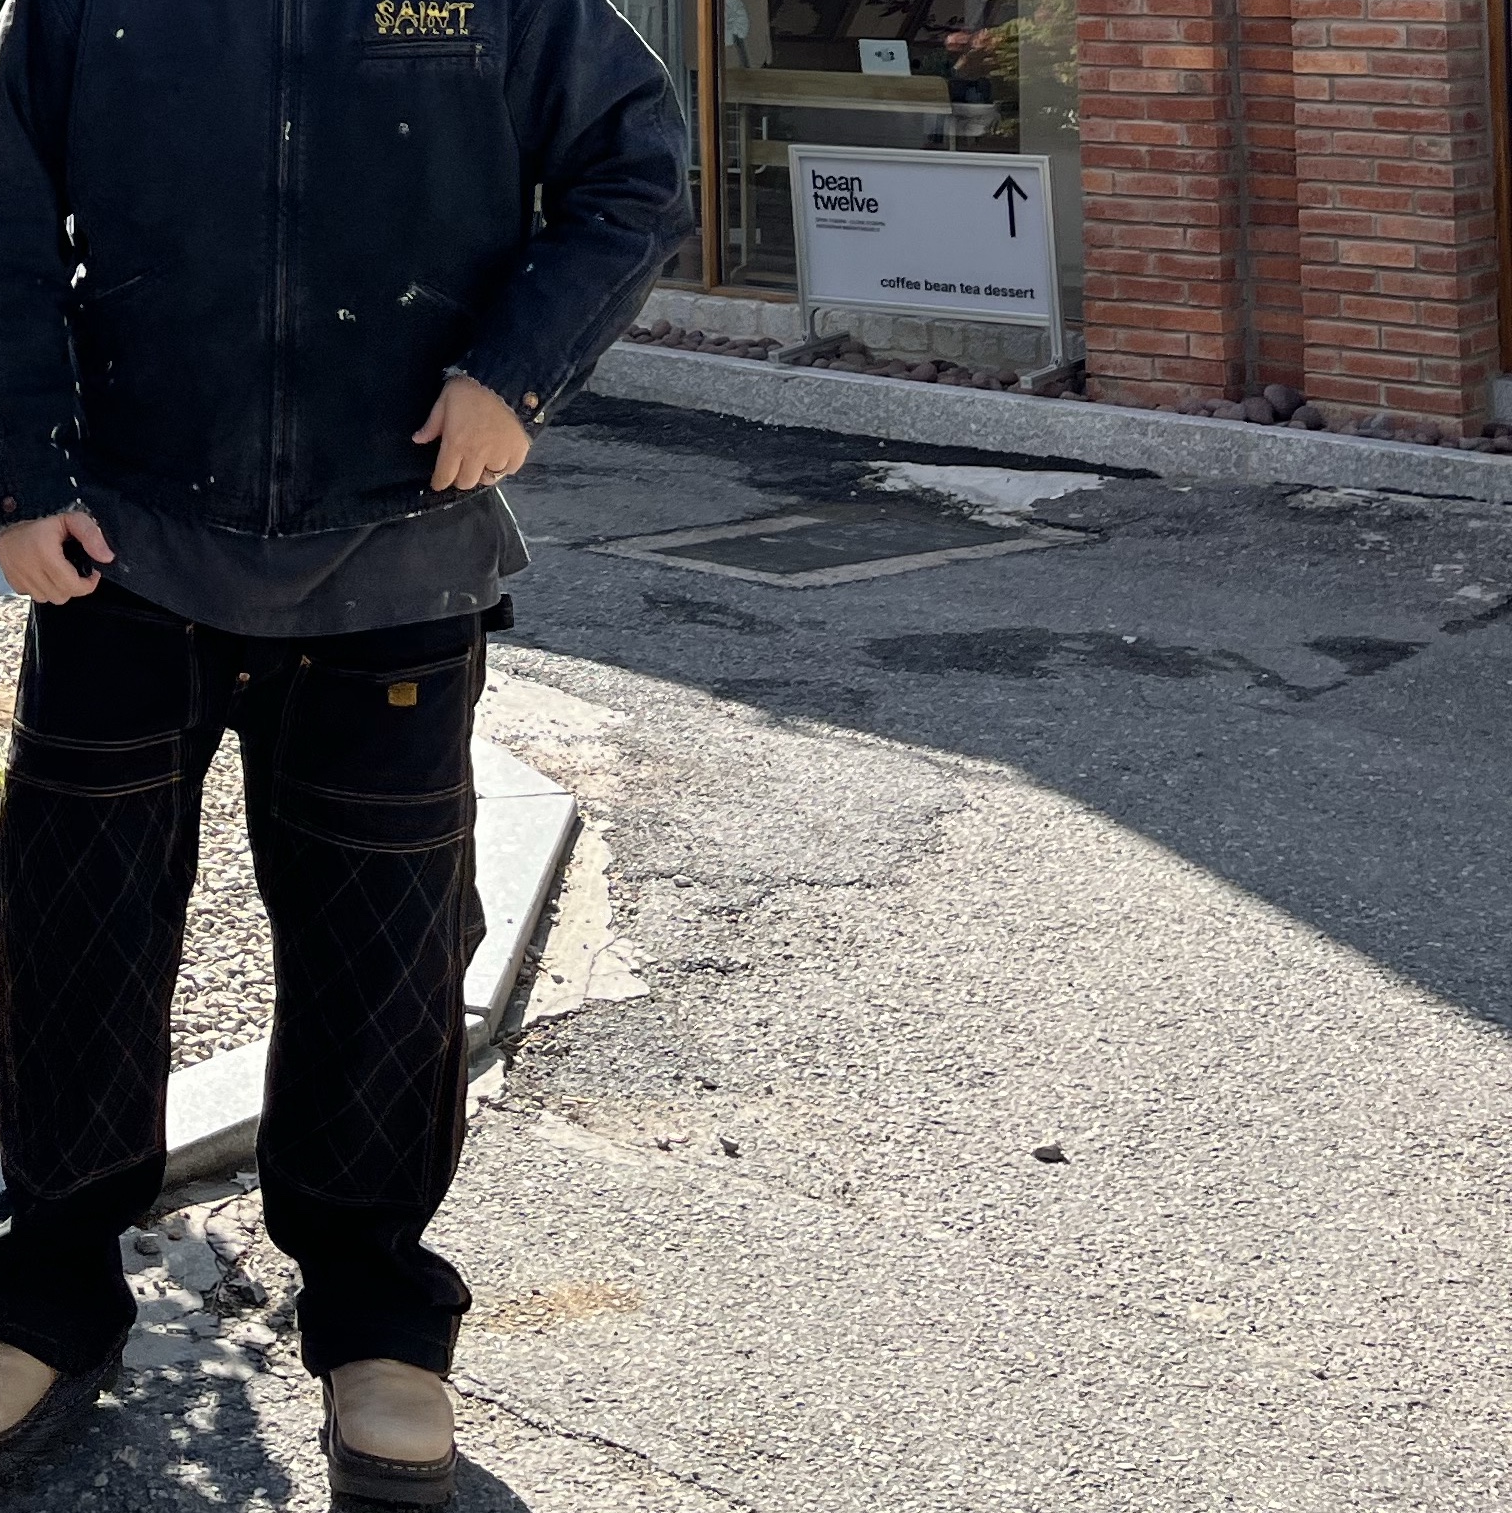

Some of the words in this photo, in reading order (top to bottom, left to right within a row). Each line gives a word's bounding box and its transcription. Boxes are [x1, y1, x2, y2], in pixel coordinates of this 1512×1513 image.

[811, 169, 863, 192] bean
[813, 191, 879, 213] twelve
[880, 276, 921, 290] coffee
[924, 279, 957, 293] bean
[959, 283, 981, 295] tea
[984, 284, 1035, 299] dessert
